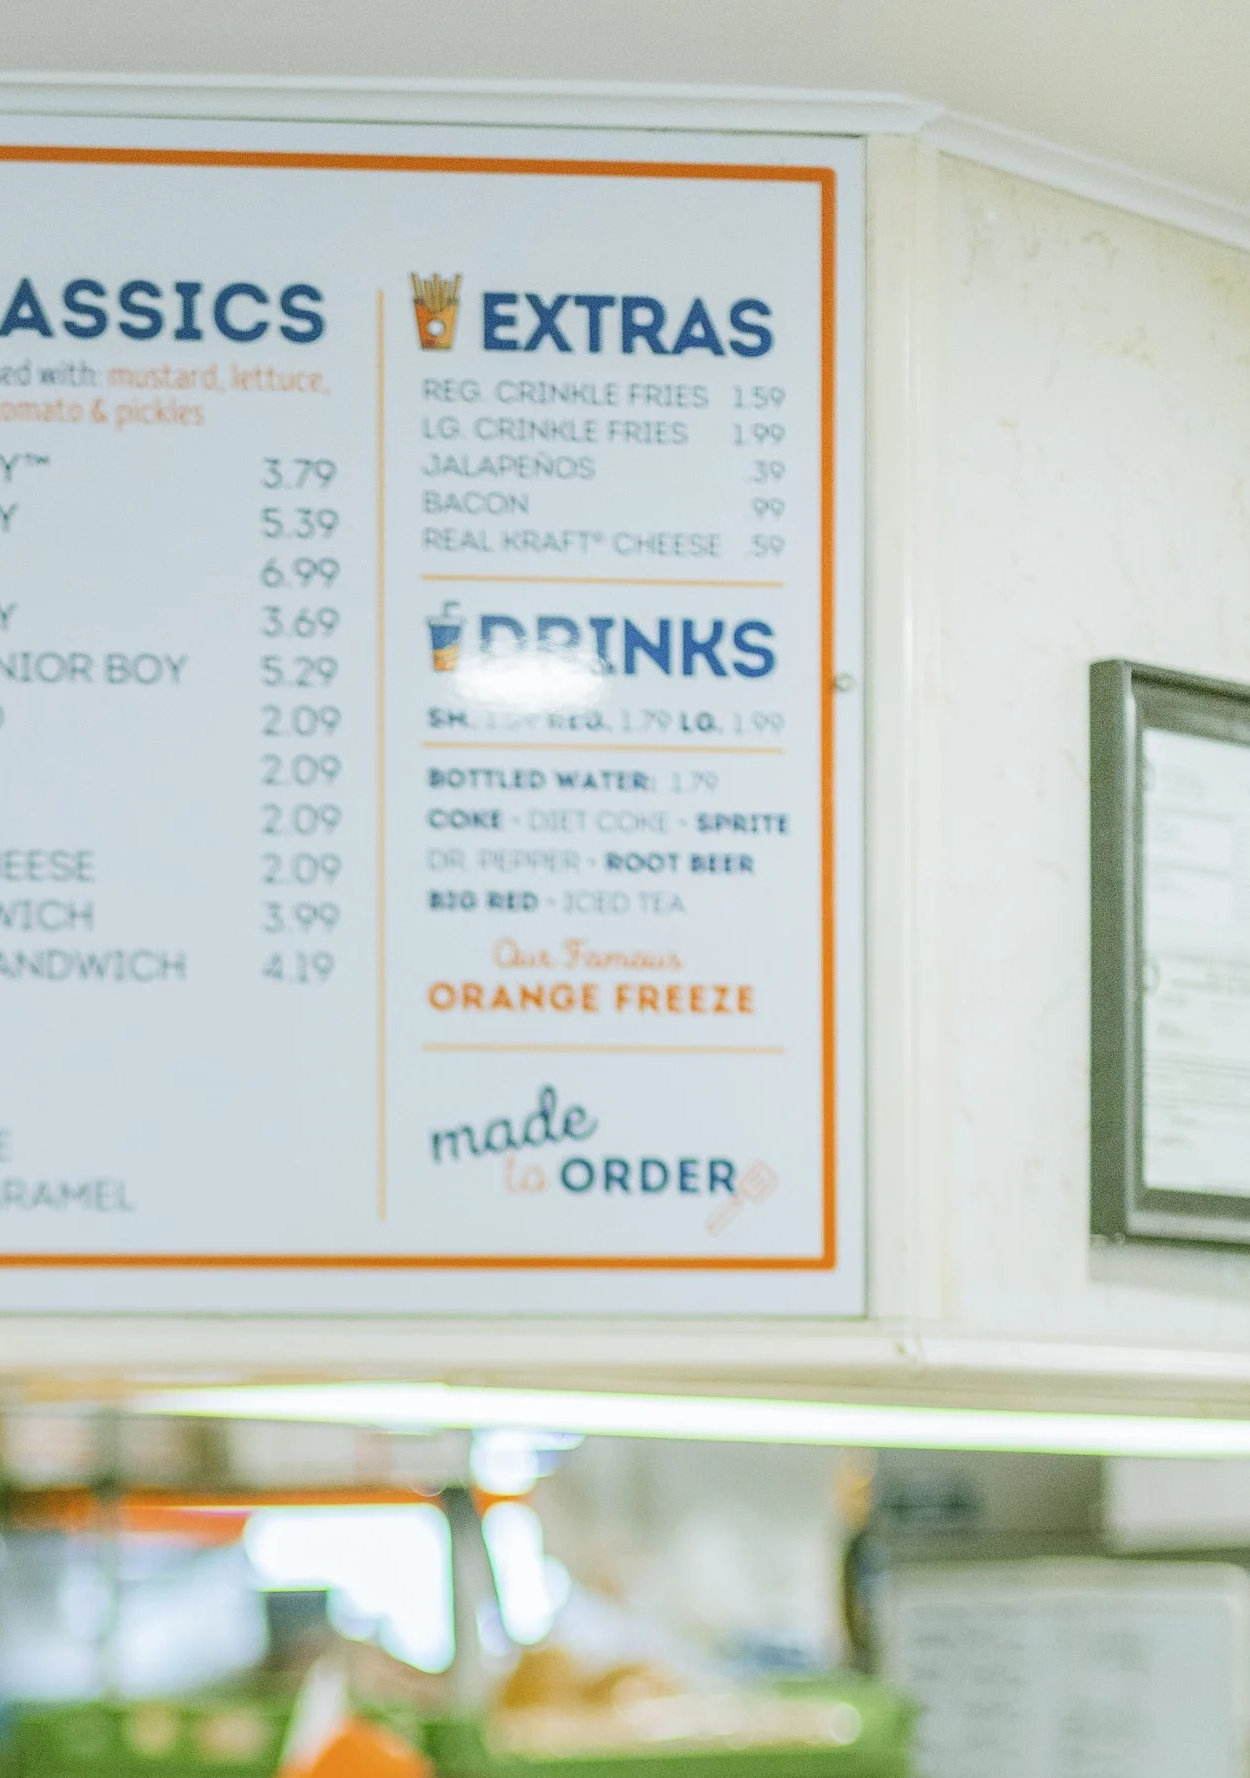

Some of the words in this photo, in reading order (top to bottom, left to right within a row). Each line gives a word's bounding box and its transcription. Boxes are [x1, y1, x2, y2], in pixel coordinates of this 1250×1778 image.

[482, 291, 774, 359] EXTRAS
[107, 363, 224, 391] mustard,
[231, 363, 330, 394] lettuce,
[495, 380, 617, 406] CRINKLE
[628, 383, 709, 409] FRIES
[89, 397, 109, 424] &
[114, 397, 205, 432] pickles
[473, 417, 597, 444] CRINKLE
[607, 420, 689, 445] FRIES
[261, 457, 337, 490] 3.79
[422, 452, 596, 480] JALAPEÑOS
[422, 490, 529, 516] BACON
[261, 506, 340, 540] 5.39
[422, 527, 493, 553] REAL
[611, 531, 720, 558] CHEESE
[259, 556, 340, 589] 6.99
[261, 605, 340, 639] 3.69
[104, 652, 188, 686] BOY
[260, 654, 339, 689] 5.29
[261, 703, 342, 738] 2.09
[261, 753, 342, 788] 2.09
[427, 767, 546, 790] BOTTLED
[554, 768, 655, 792] WATER:
[261, 802, 342, 837] 2.09
[426, 808, 502, 831] COKE
[529, 809, 586, 833] DIET
[595, 810, 668, 835] COKE
[696, 812, 789, 836] SPRITE
[261, 851, 343, 886] 2.09
[478, 849, 581, 873] PEPPER
[604, 851, 680, 874] ROOT
[689, 853, 754, 875] BEER
[261, 900, 341, 935] 3.99
[427, 889, 478, 912] BIG
[486, 890, 539, 912] RED
[563, 890, 631, 915] ICED
[638, 891, 686, 915] TEA
[261, 950, 335, 985] 4.19
[493, 937, 556, 970] Our
[563, 937, 685, 971] Famous
[427, 981, 599, 1013] ORANGE
[615, 983, 753, 1015] FREEZE
[430, 1084, 598, 1164] made
[504, 1154, 547, 1194] to
[559, 1156, 736, 1195] ORDER
